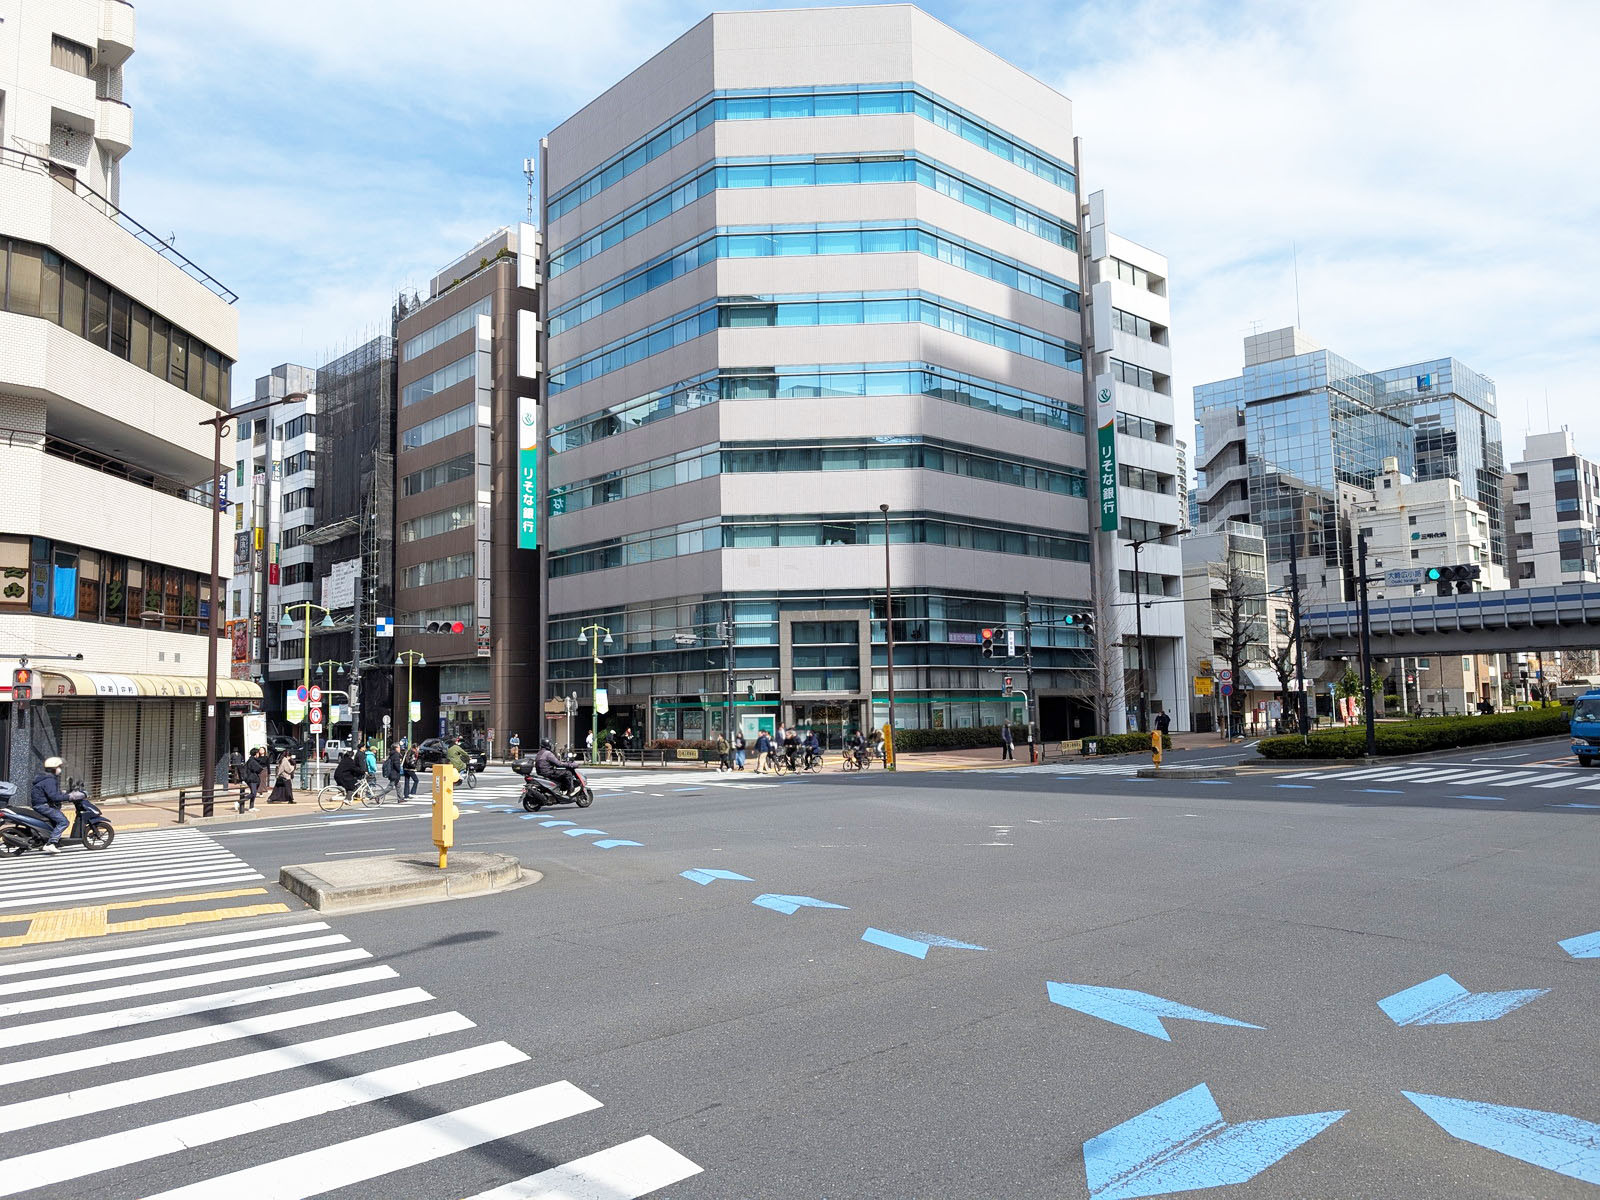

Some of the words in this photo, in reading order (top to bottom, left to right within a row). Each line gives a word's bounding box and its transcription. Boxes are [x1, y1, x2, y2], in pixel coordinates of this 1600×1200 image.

[523, 467, 534, 533] りそな銀行
[1102, 446, 1115, 514] りそな銀行
[1388, 570, 1422, 580] 大崎広小路
